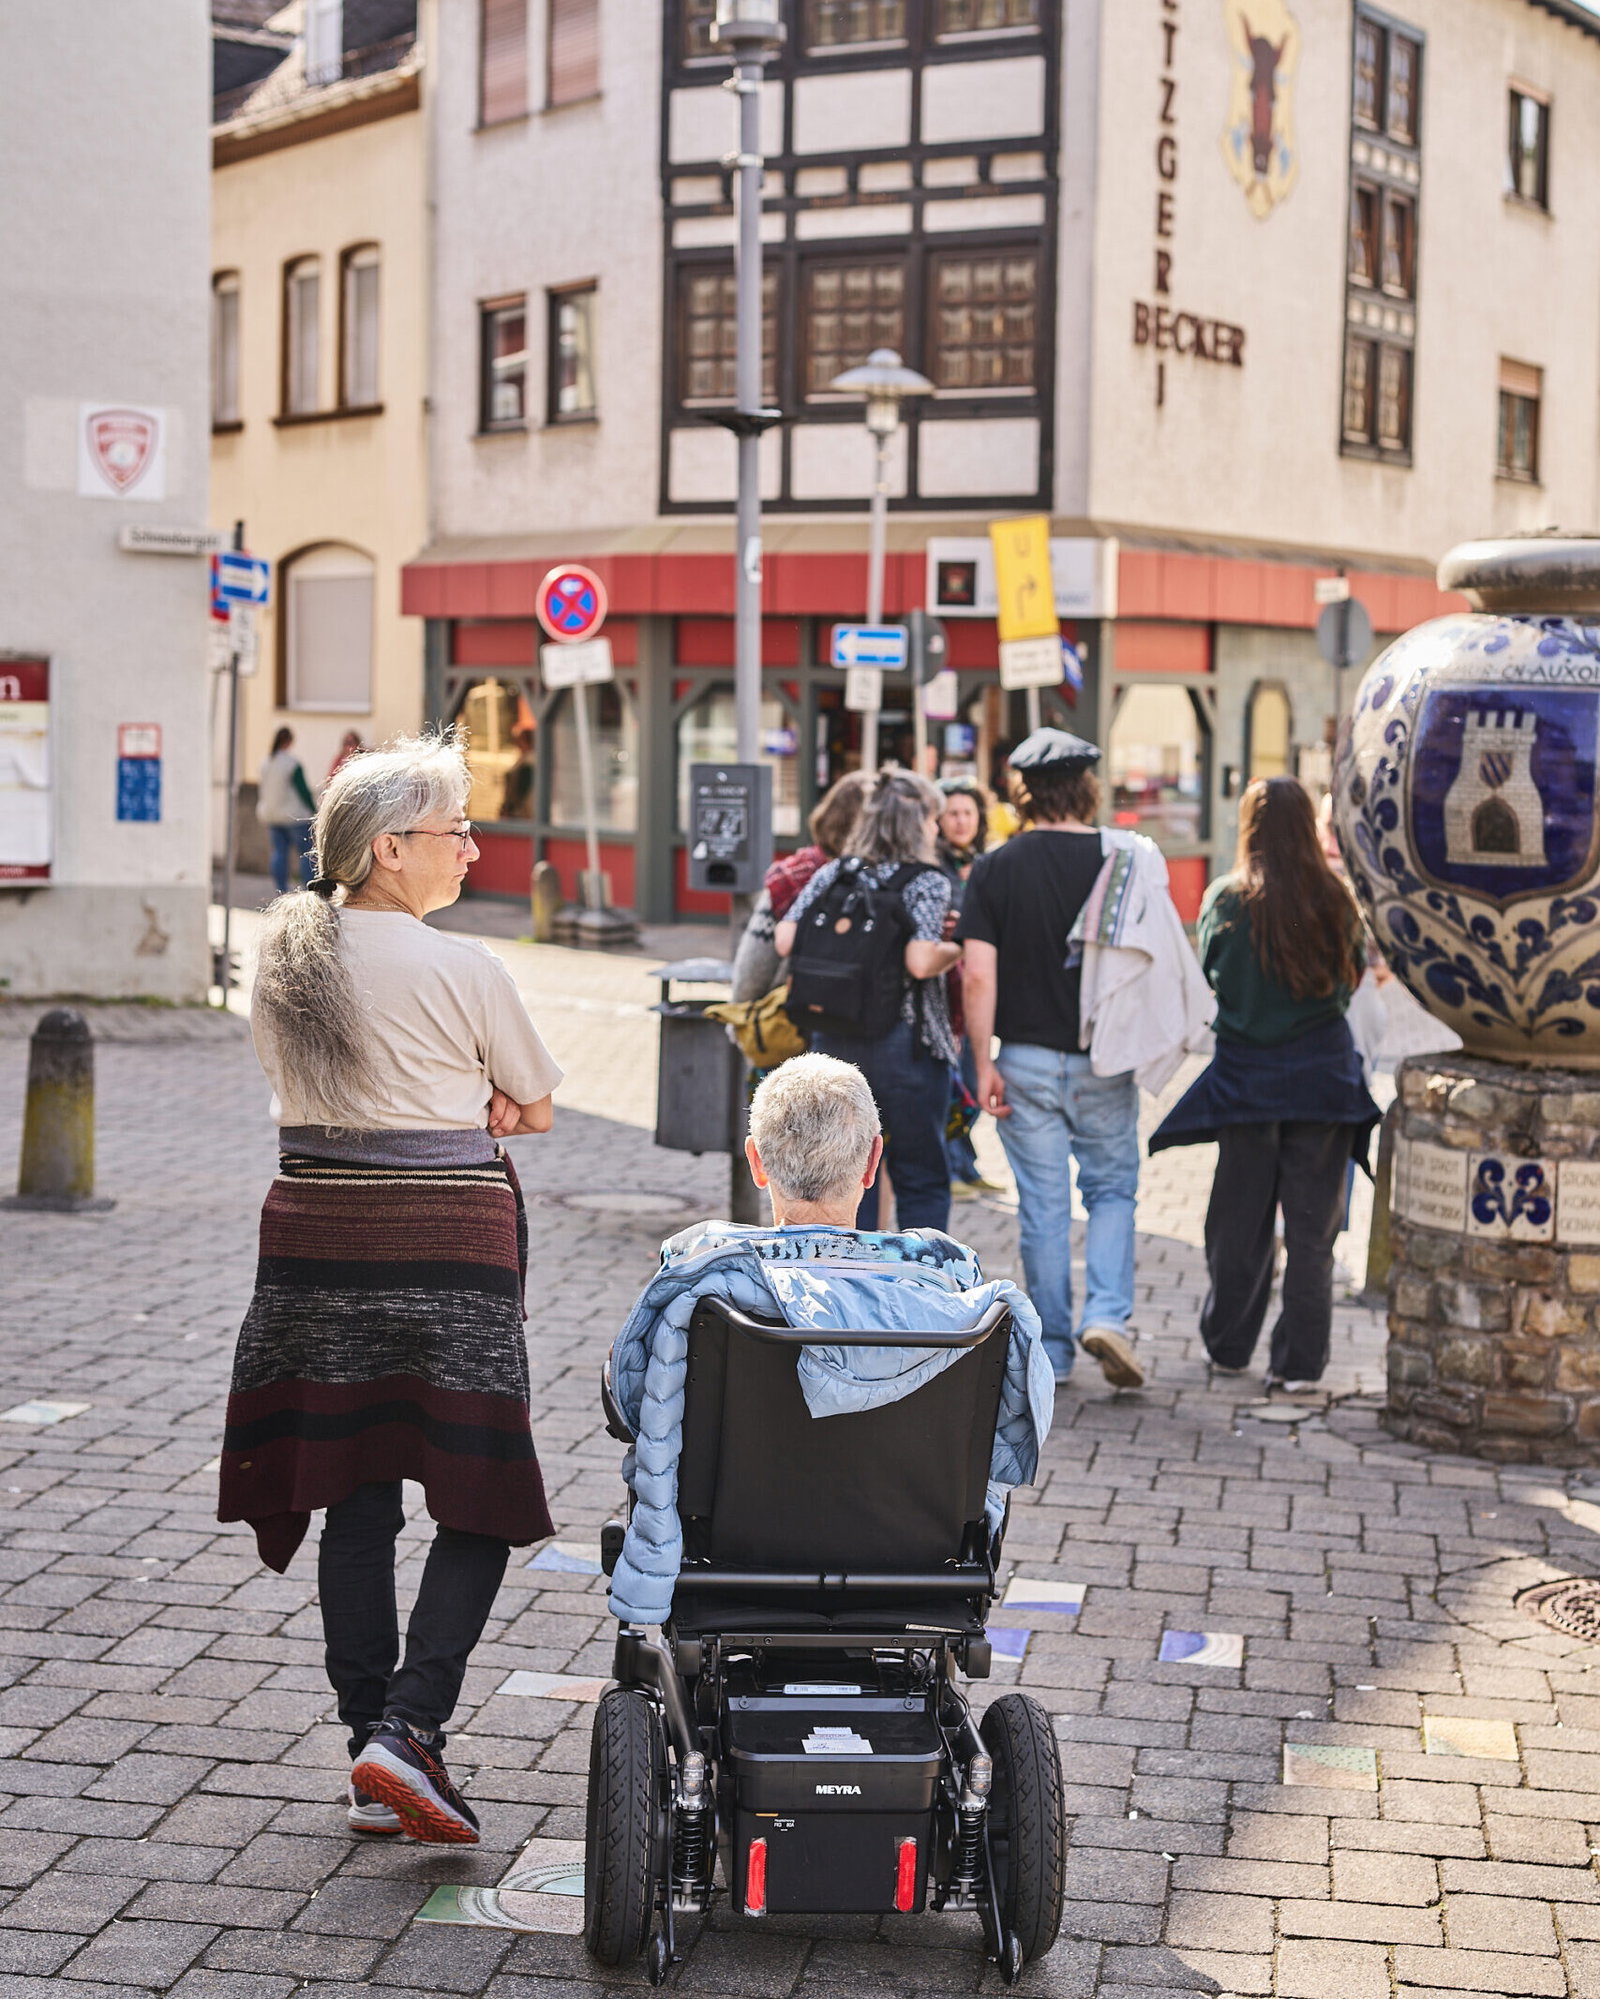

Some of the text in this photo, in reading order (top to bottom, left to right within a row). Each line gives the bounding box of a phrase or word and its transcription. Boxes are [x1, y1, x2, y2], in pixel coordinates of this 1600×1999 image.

[1154, 0, 1178, 407] TZGEREI
[1133, 300, 1246, 368] BECKER
[815, 1785, 862, 1795] MEYRA
